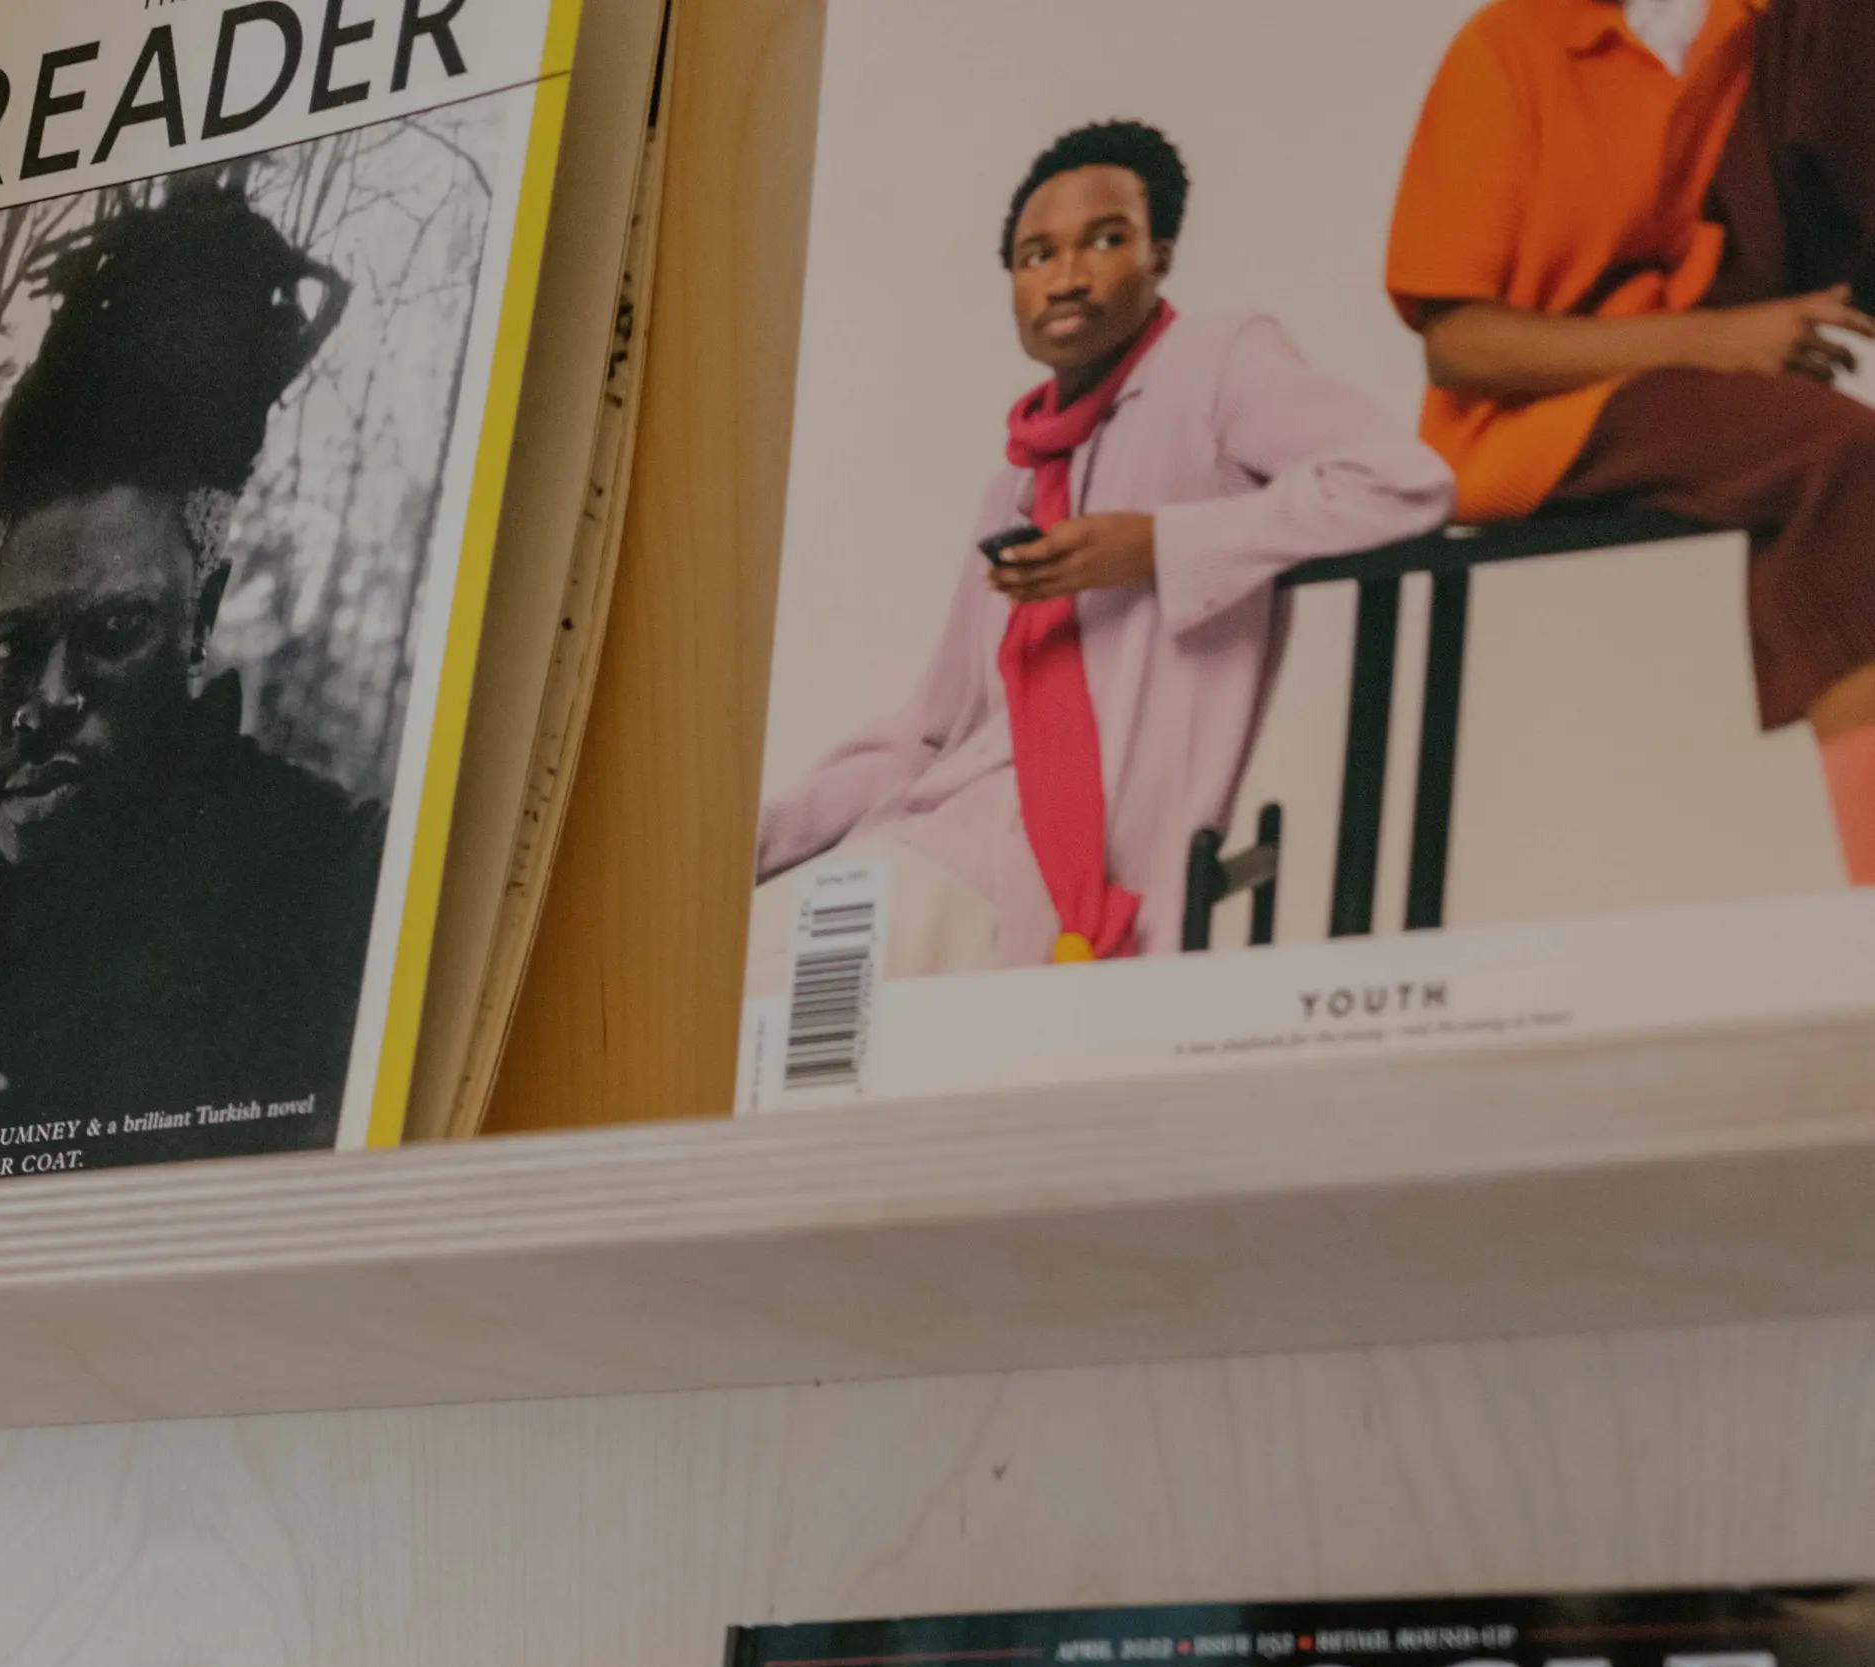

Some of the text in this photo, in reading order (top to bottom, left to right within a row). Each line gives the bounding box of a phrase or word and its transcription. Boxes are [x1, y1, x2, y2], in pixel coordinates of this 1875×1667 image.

[1299, 980, 1449, 1021] YOUTH
[86, 1117, 103, 1138] &
[107, 1122, 117, 1135] a
[123, 1111, 193, 1134] brilliant
[196, 1101, 262, 1126] Turkish
[266, 1092, 316, 1118] novel
[21, 1150, 85, 1173] COAT.
